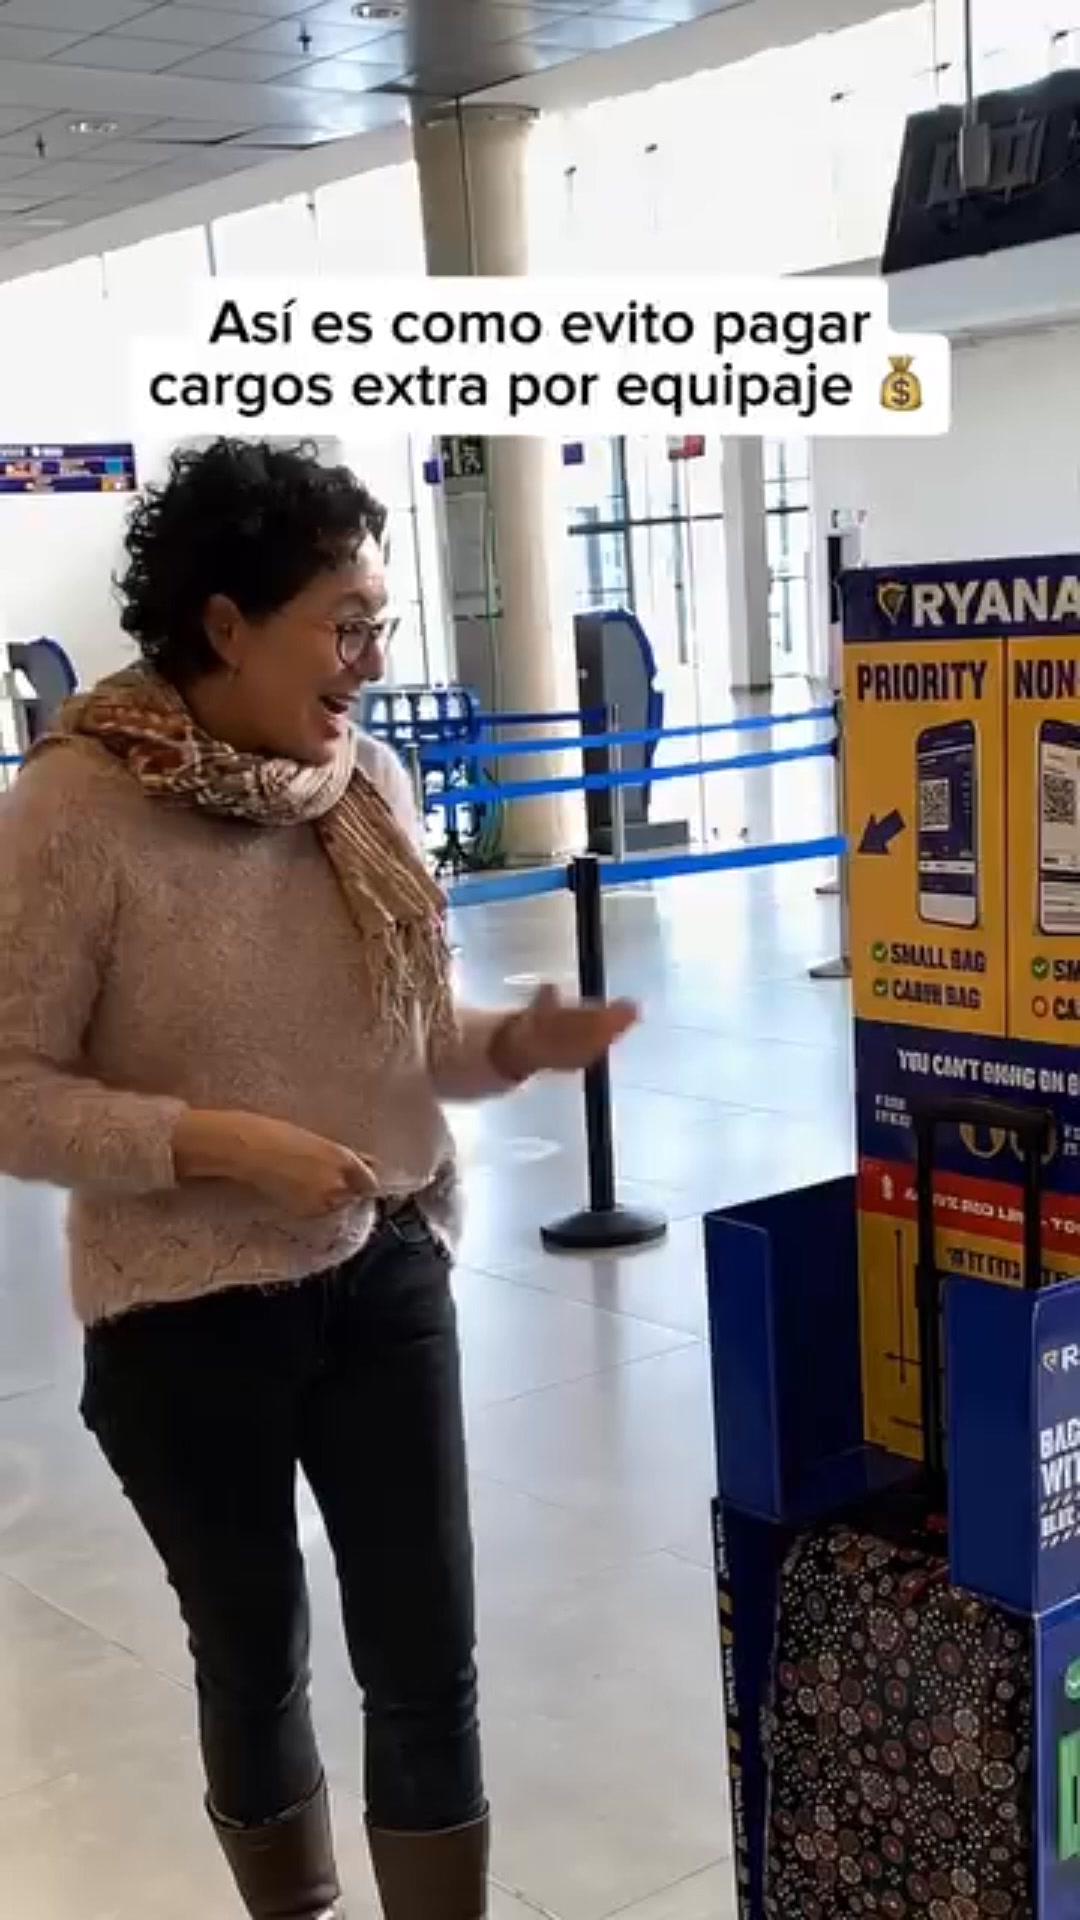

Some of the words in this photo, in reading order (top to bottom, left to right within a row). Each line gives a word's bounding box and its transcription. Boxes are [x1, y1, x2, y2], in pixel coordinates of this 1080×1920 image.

[857, 660, 988, 700] PRIORITY
[890, 943, 949, 970] SMALL
[950, 948, 986, 973] BAG
[893, 978, 943, 1006] CABIN
[944, 984, 981, 1009] BAG
[897, 1048, 931, 1075] YOU
